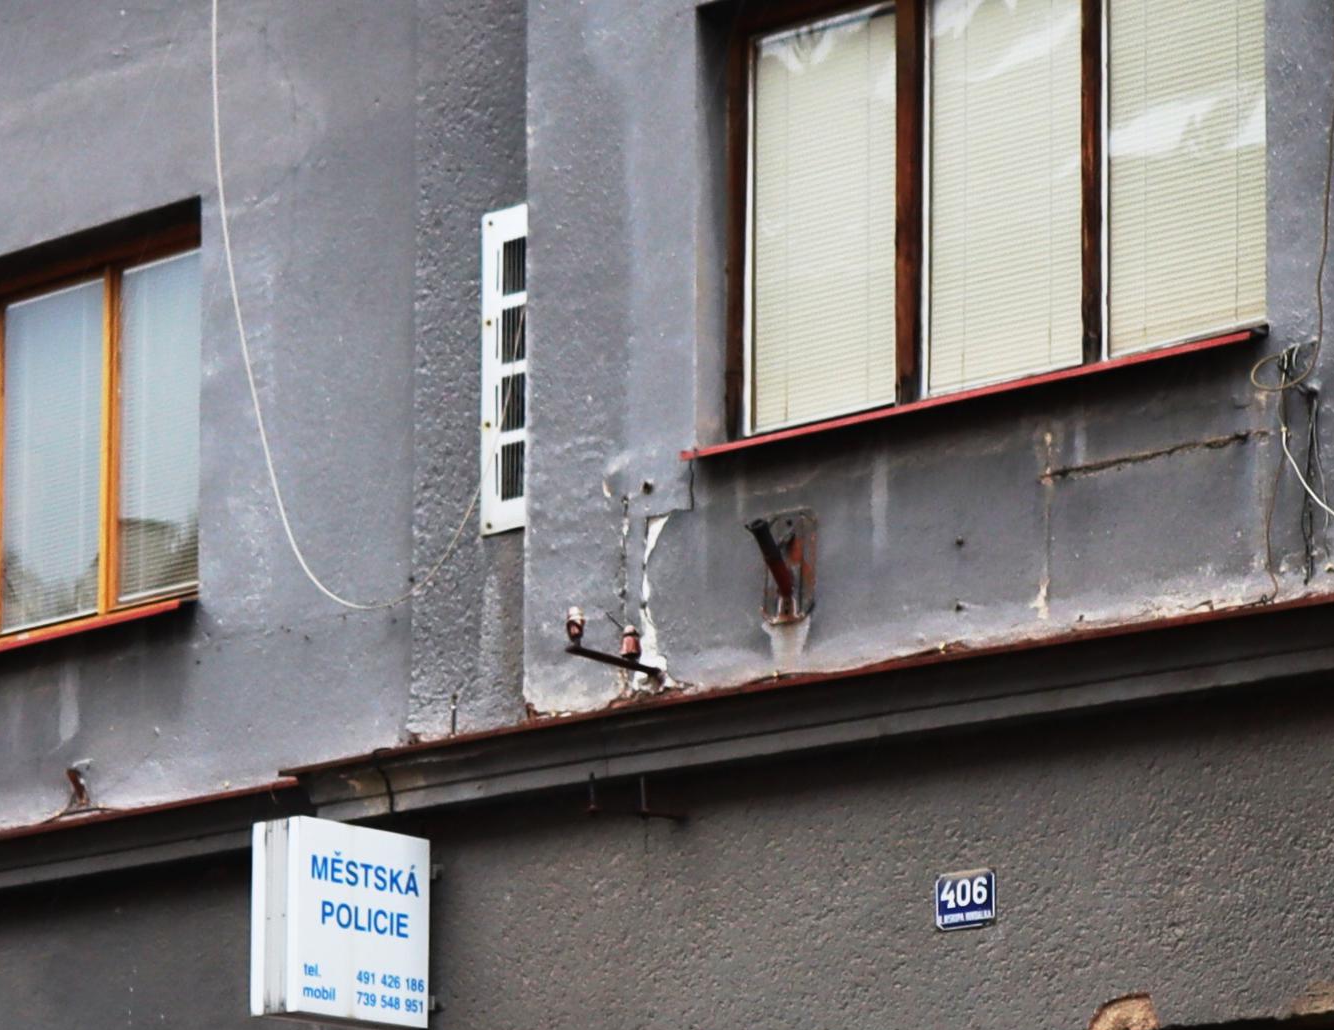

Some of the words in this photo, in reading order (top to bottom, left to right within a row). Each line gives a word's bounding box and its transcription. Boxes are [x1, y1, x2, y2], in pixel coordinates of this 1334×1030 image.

[310, 850, 419, 897] MĚSTSKÁ
[940, 876, 988, 909] 406
[321, 901, 409, 938] POLICIE
[303, 962, 322, 977] tel.
[356, 970, 376, 986] 491
[380, 974, 401, 990] 426
[405, 977, 425, 993] 186
[303, 985, 336, 1001] mobil
[356, 991, 377, 1007] 739
[380, 994, 401, 1010] 548
[405, 998, 424, 1014] 951
